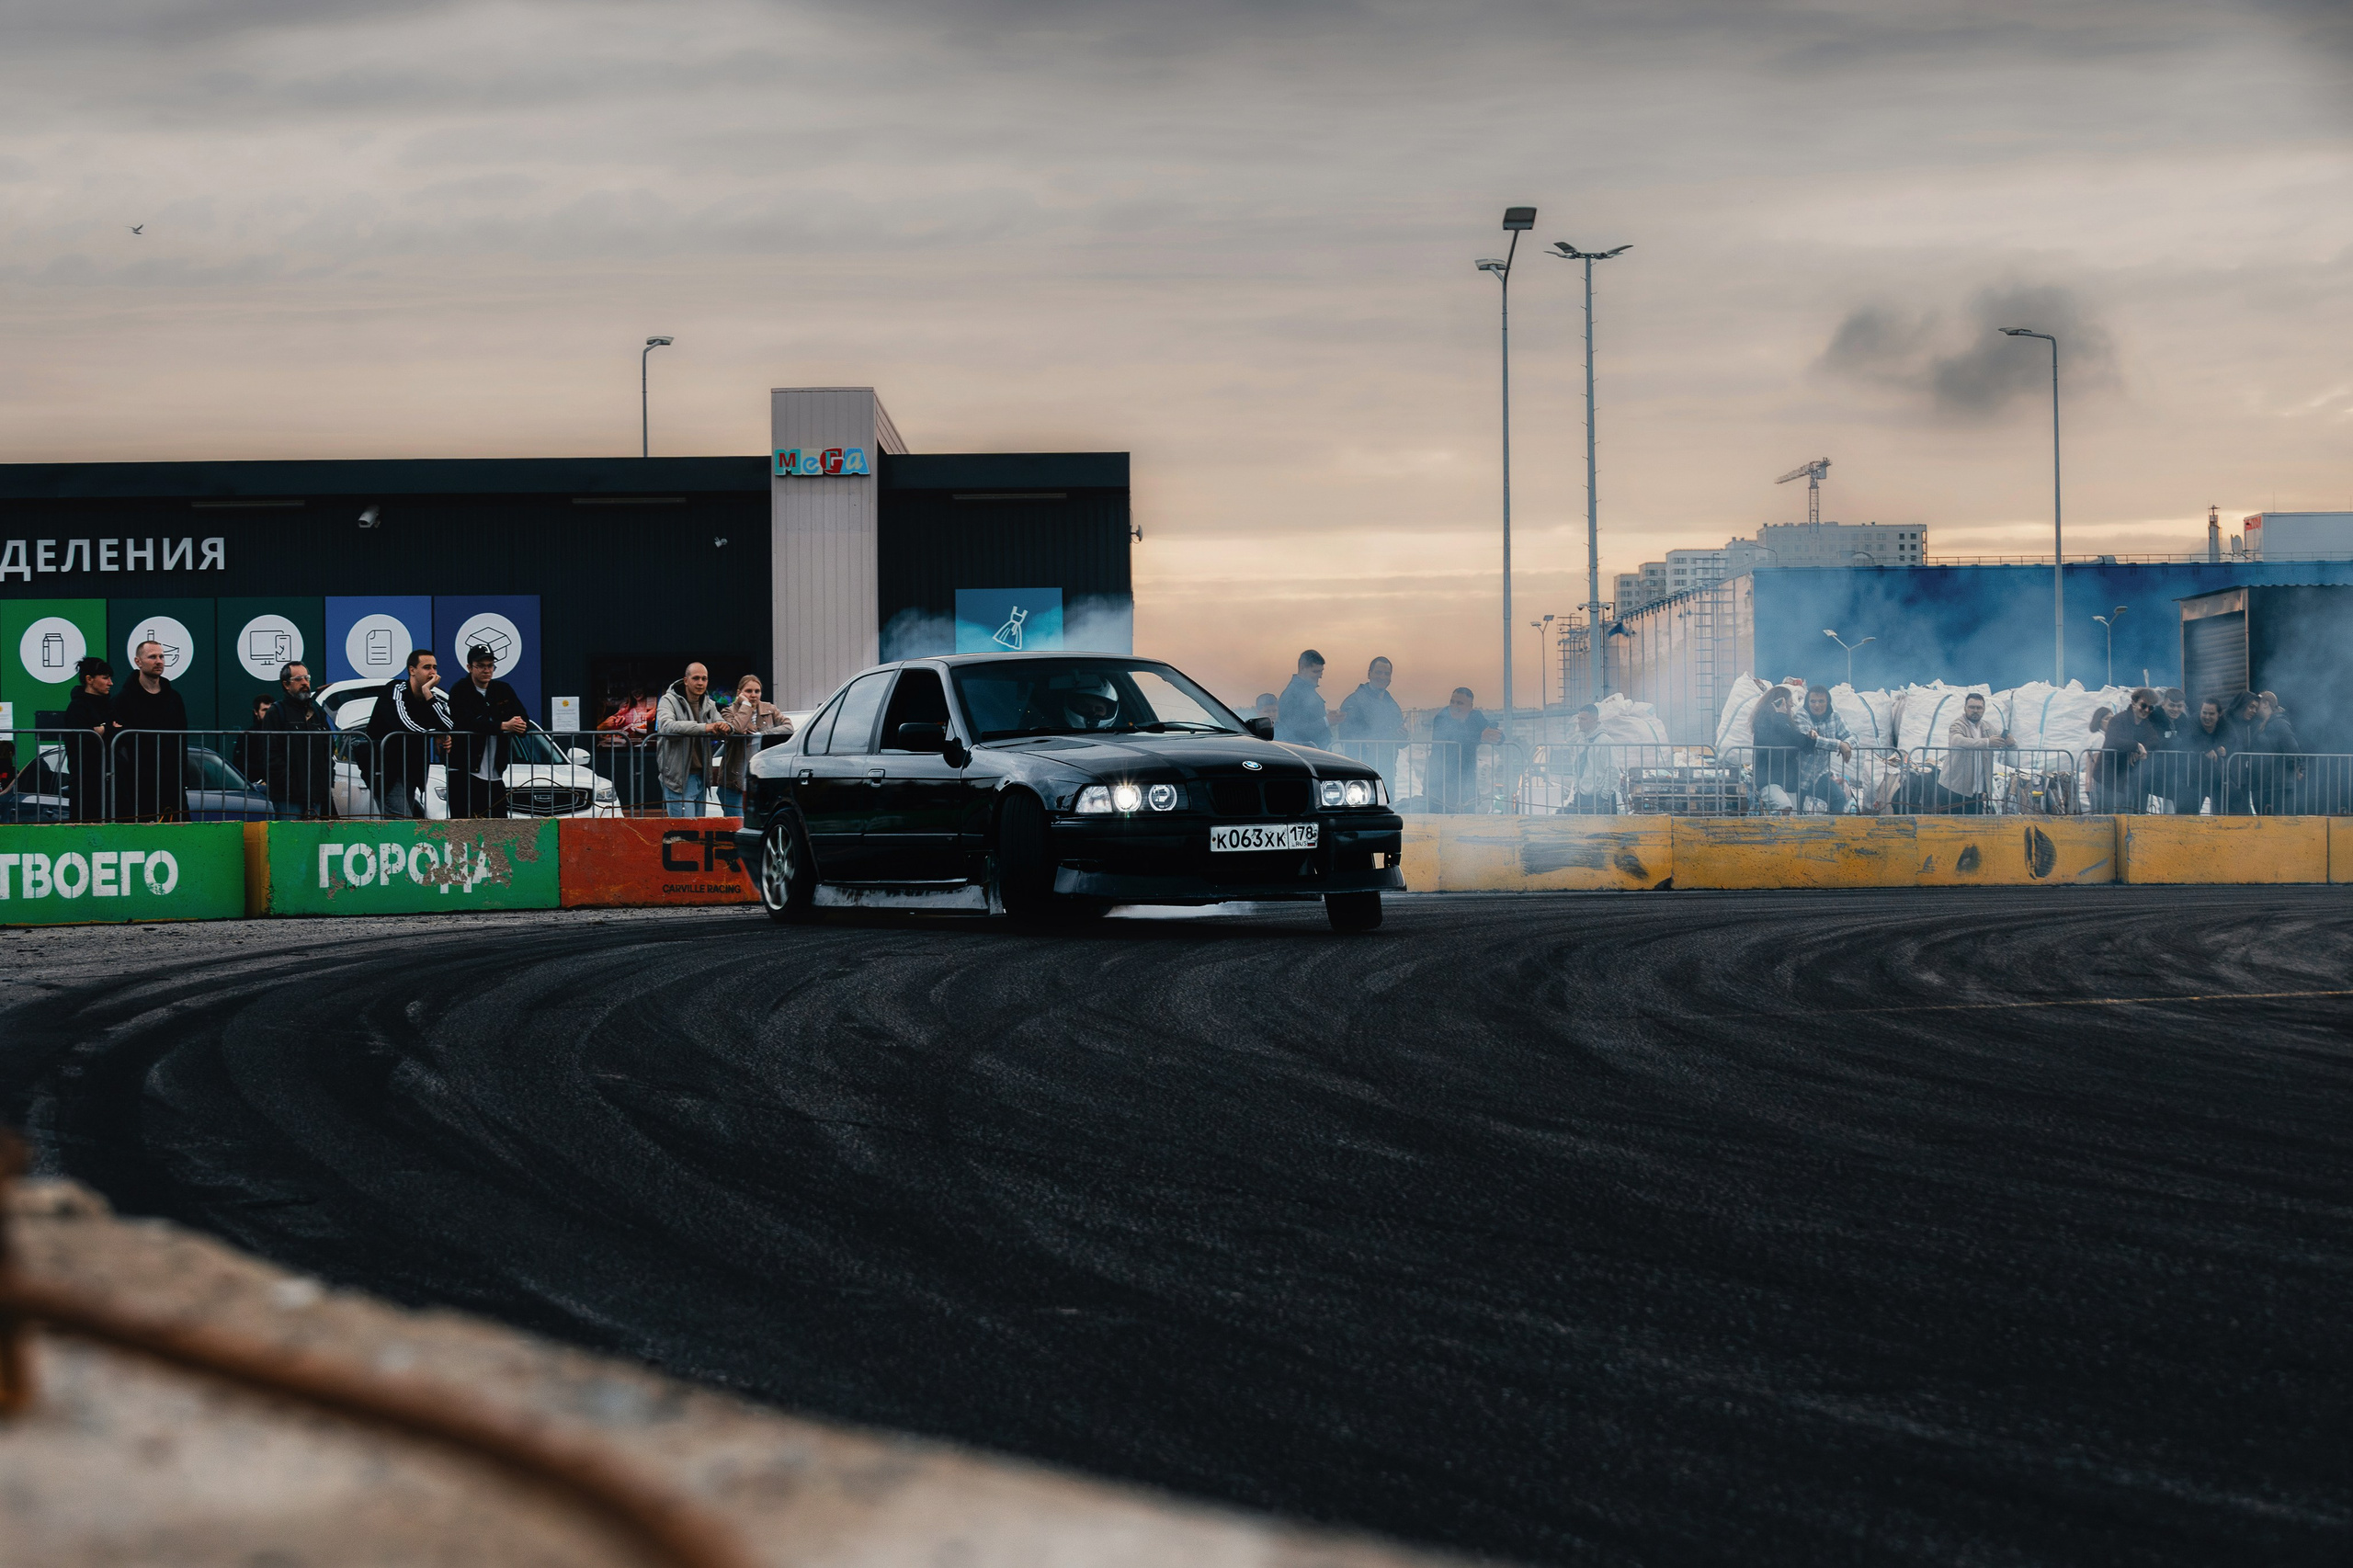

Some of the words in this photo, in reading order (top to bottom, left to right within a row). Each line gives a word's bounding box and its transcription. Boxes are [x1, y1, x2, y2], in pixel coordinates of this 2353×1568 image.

[0, 537, 225, 582] ДЕЛЕНИЯ
[663, 830, 742, 873] CR
[1217, 828, 1287, 849] К063ХК
[1290, 825, 1313, 841] 178
[0, 850, 178, 900] ТВОЕГО
[662, 884, 705, 893] CARVILLE
[707, 884, 742, 893] RACING
